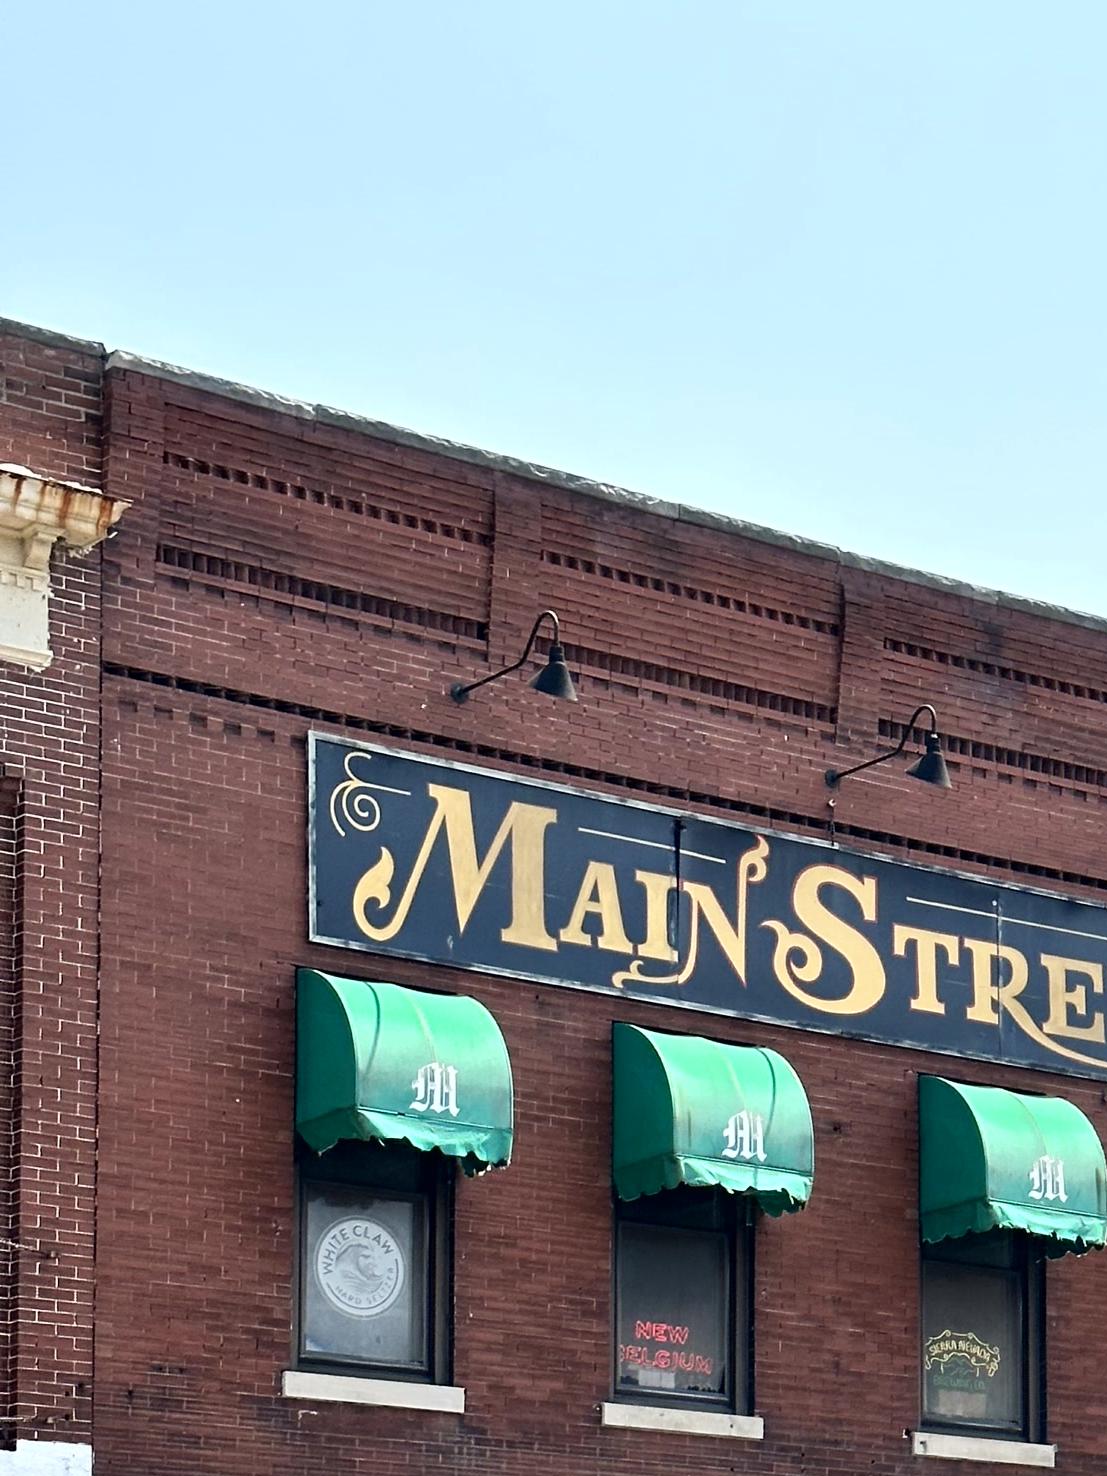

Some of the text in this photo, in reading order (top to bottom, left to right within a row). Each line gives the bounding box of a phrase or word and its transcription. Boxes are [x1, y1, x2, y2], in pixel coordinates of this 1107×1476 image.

[353, 784, 769, 988] MAIN
[321, 1224, 394, 1275] WHITE CLAW
[635, 1320, 689, 1345] NEW
